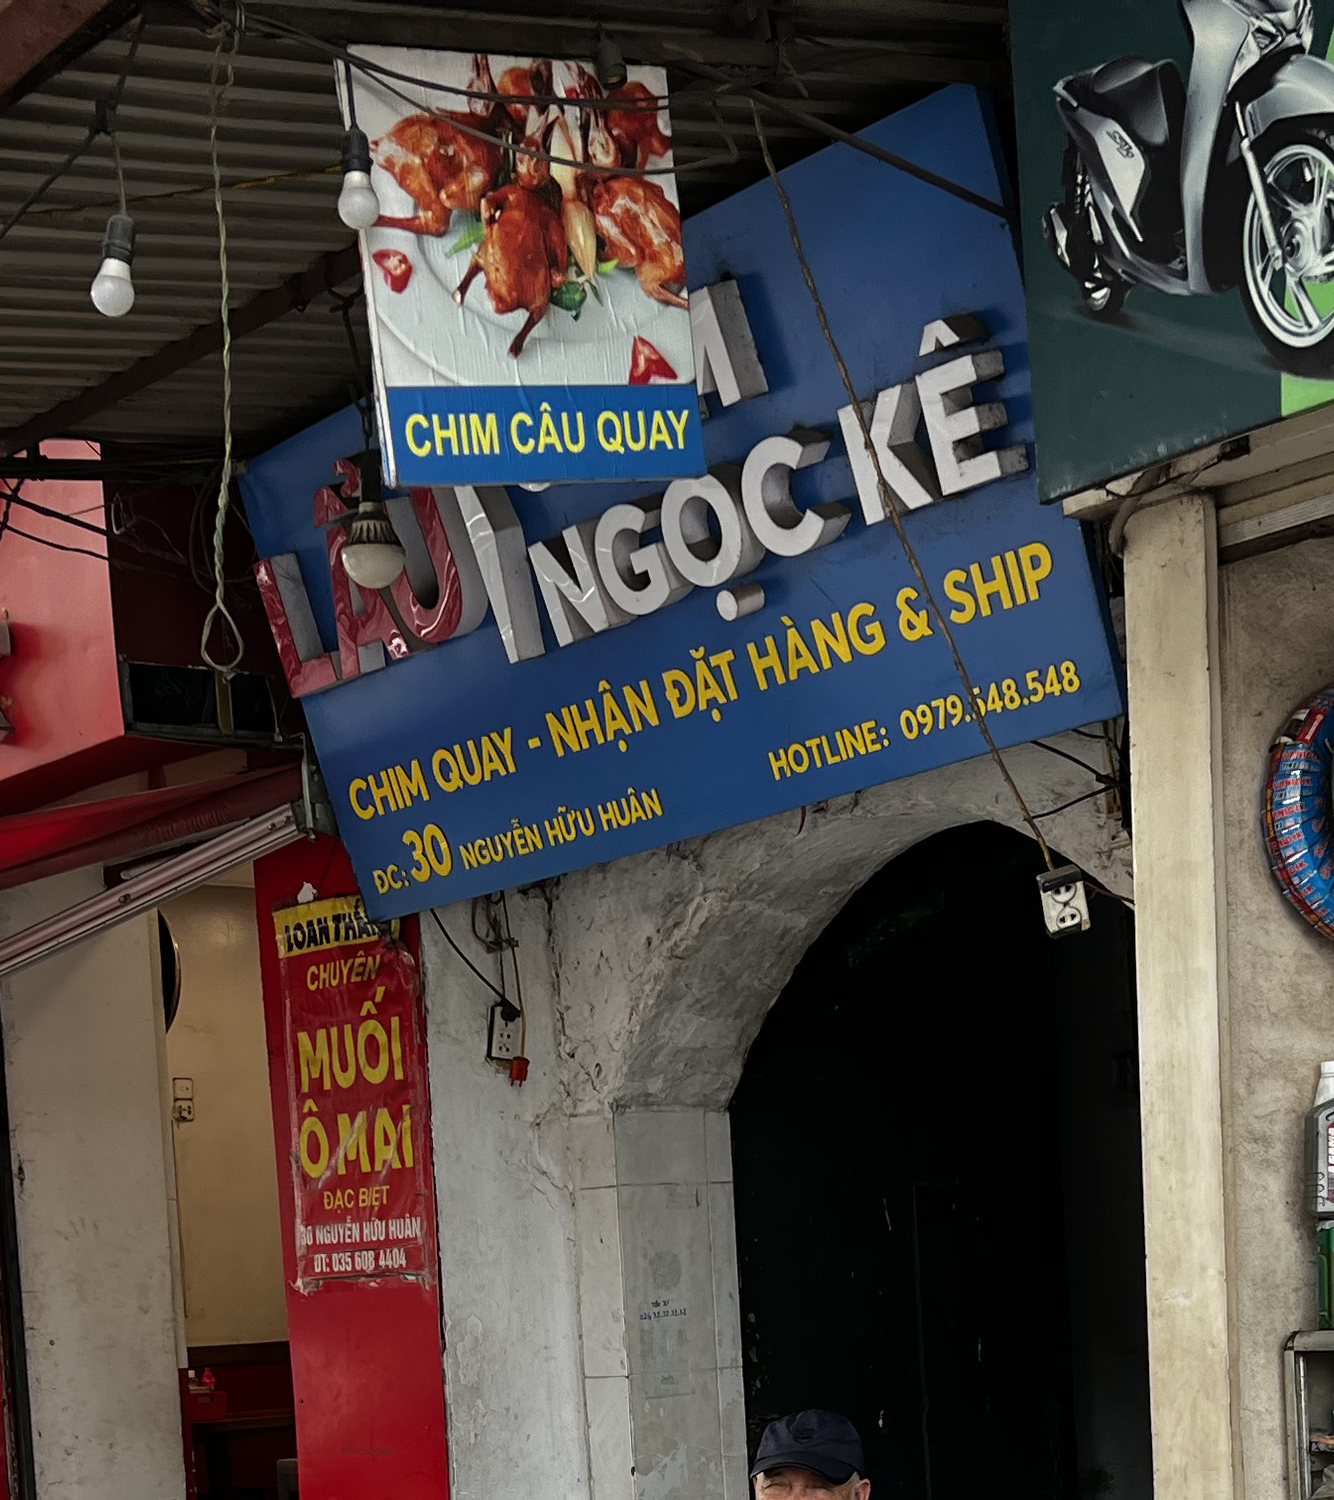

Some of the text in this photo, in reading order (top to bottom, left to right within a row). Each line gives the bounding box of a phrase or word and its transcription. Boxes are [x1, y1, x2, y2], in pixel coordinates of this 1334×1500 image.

[404, 402, 689, 457] CHIM CÂU QUAY
[527, 435, 837, 648] NGỌC
[836, 318, 1007, 527] KÊ
[348, 758, 431, 821] CHIM
[431, 726, 518, 793] QUAY
[544, 679, 660, 758] NHẬN
[660, 645, 740, 724] ĐẶT
[746, 601, 887, 691] HÀNG
[896, 585, 935, 642] &
[943, 540, 1054, 625] SHIP
[768, 720, 891, 782] HOTLINE:
[402, 822, 453, 883] 30
[458, 817, 544, 871] NGUYỄN
[543, 805, 596, 847] HỮU
[597, 786, 664, 832] HUÂN
[306, 949, 382, 992] CHUYÊN
[296, 985, 405, 1094] MUỐI
[298, 1098, 416, 1180] Ô MAI
[315, 1215, 360, 1246] NGUYỄN
[388, 1212, 422, 1240] HUÂN
[332, 1252, 353, 1273] 035
[378, 1247, 407, 1270] 4404
